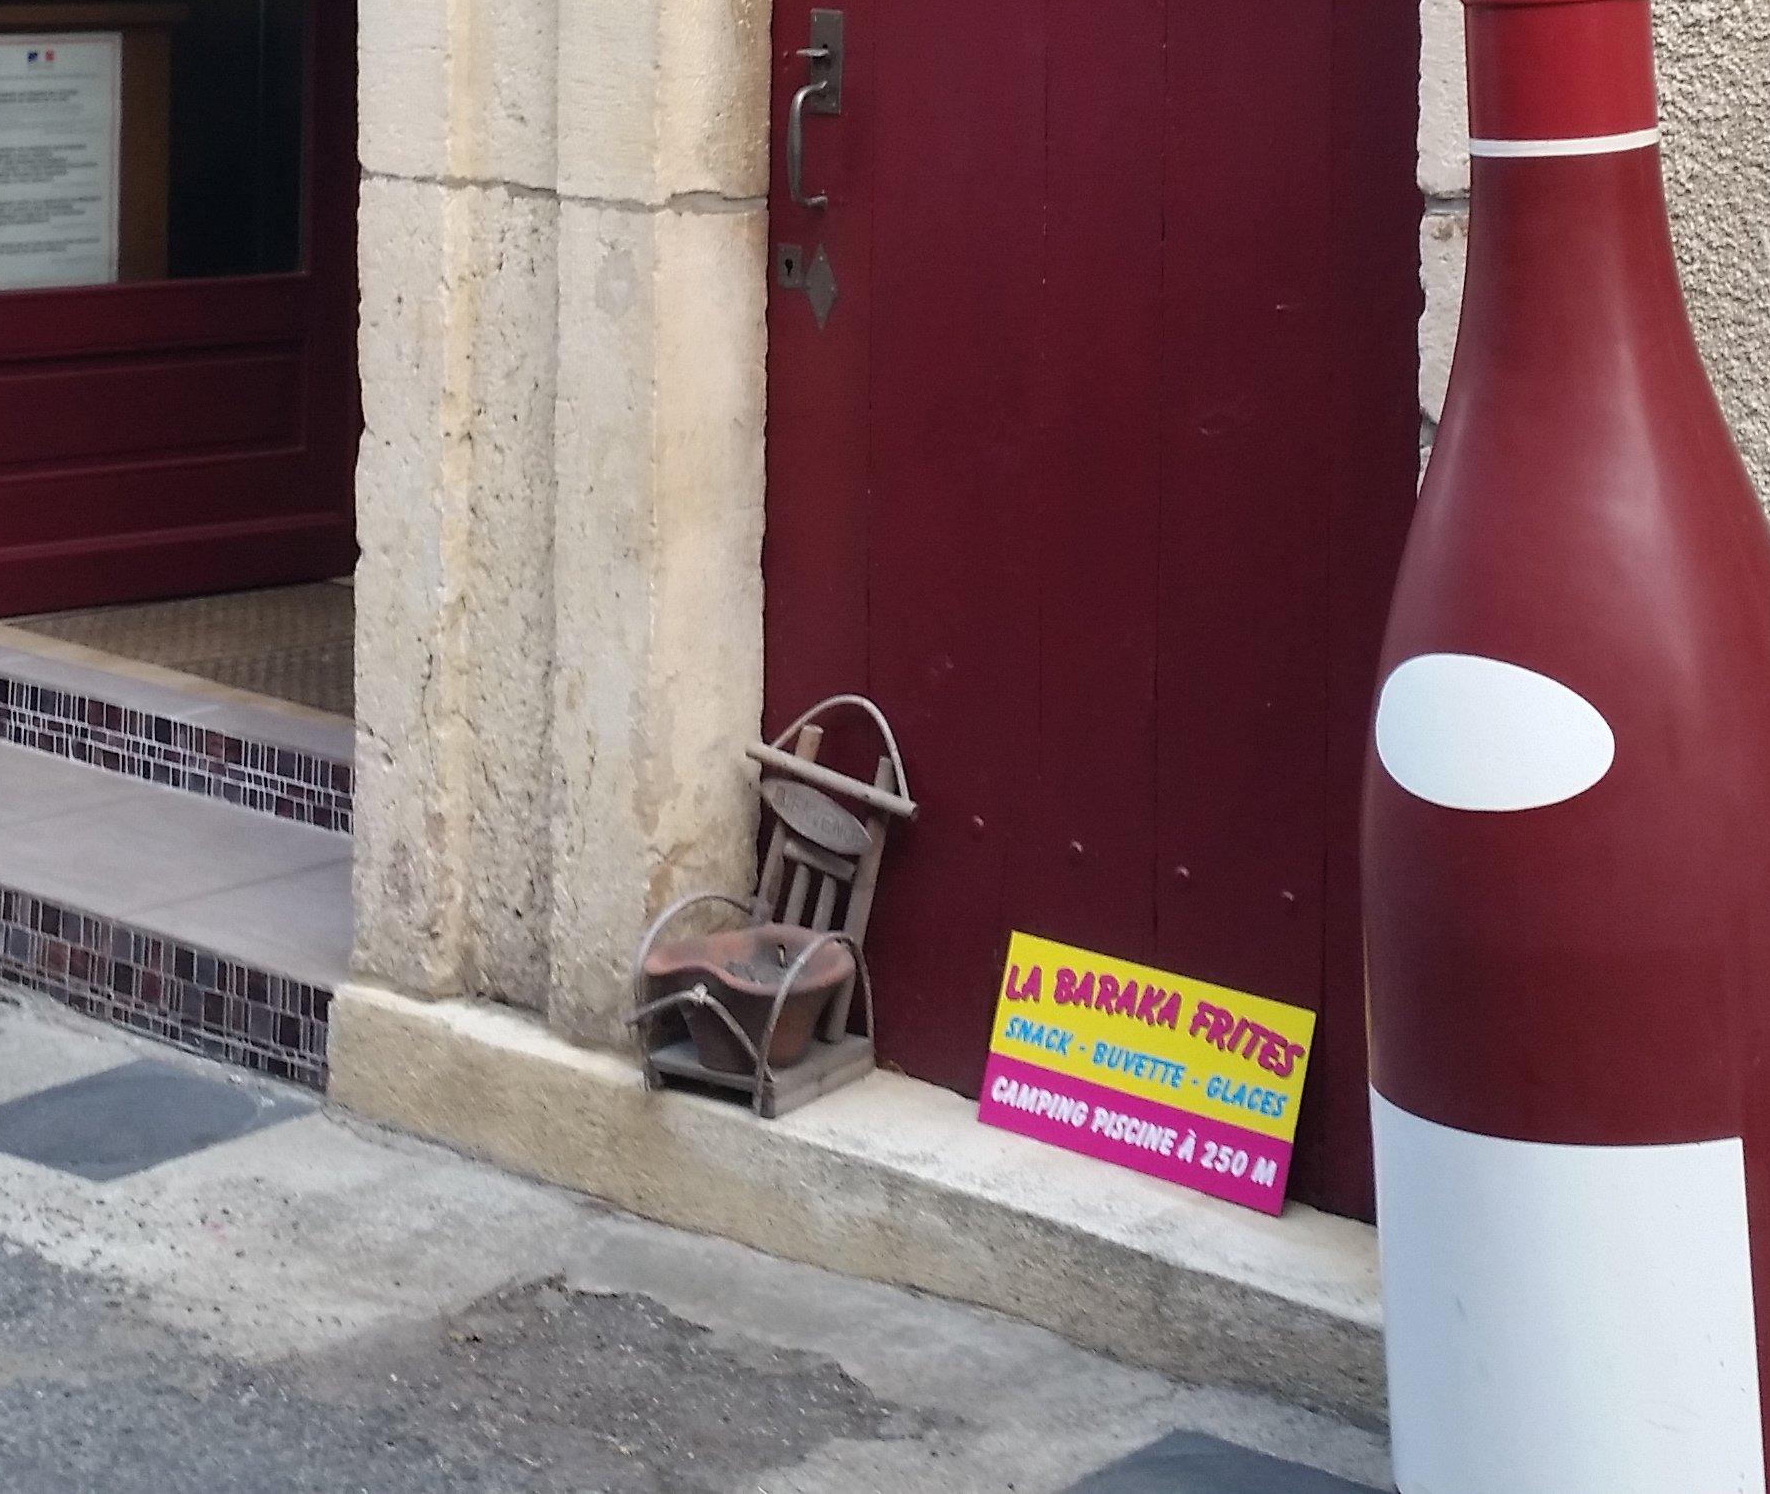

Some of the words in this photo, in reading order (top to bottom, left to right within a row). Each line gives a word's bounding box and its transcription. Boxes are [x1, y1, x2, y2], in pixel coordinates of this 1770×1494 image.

[1005, 1016, 1074, 1056] SNACK
[1092, 1041, 1185, 1090] BUVETTE
[1206, 1074, 1288, 1119] GLACES
[1006, 965, 1042, 1003] LA
[1053, 967, 1183, 1031] BARAKA
[1188, 1000, 1306, 1078] FRITES
[991, 1075, 1089, 1128] CAMPING
[1090, 1106, 1178, 1156] PISCINE
[1177, 1128, 1197, 1165] À
[1200, 1140, 1249, 1178] 250
[1250, 1156, 1278, 1188] M
